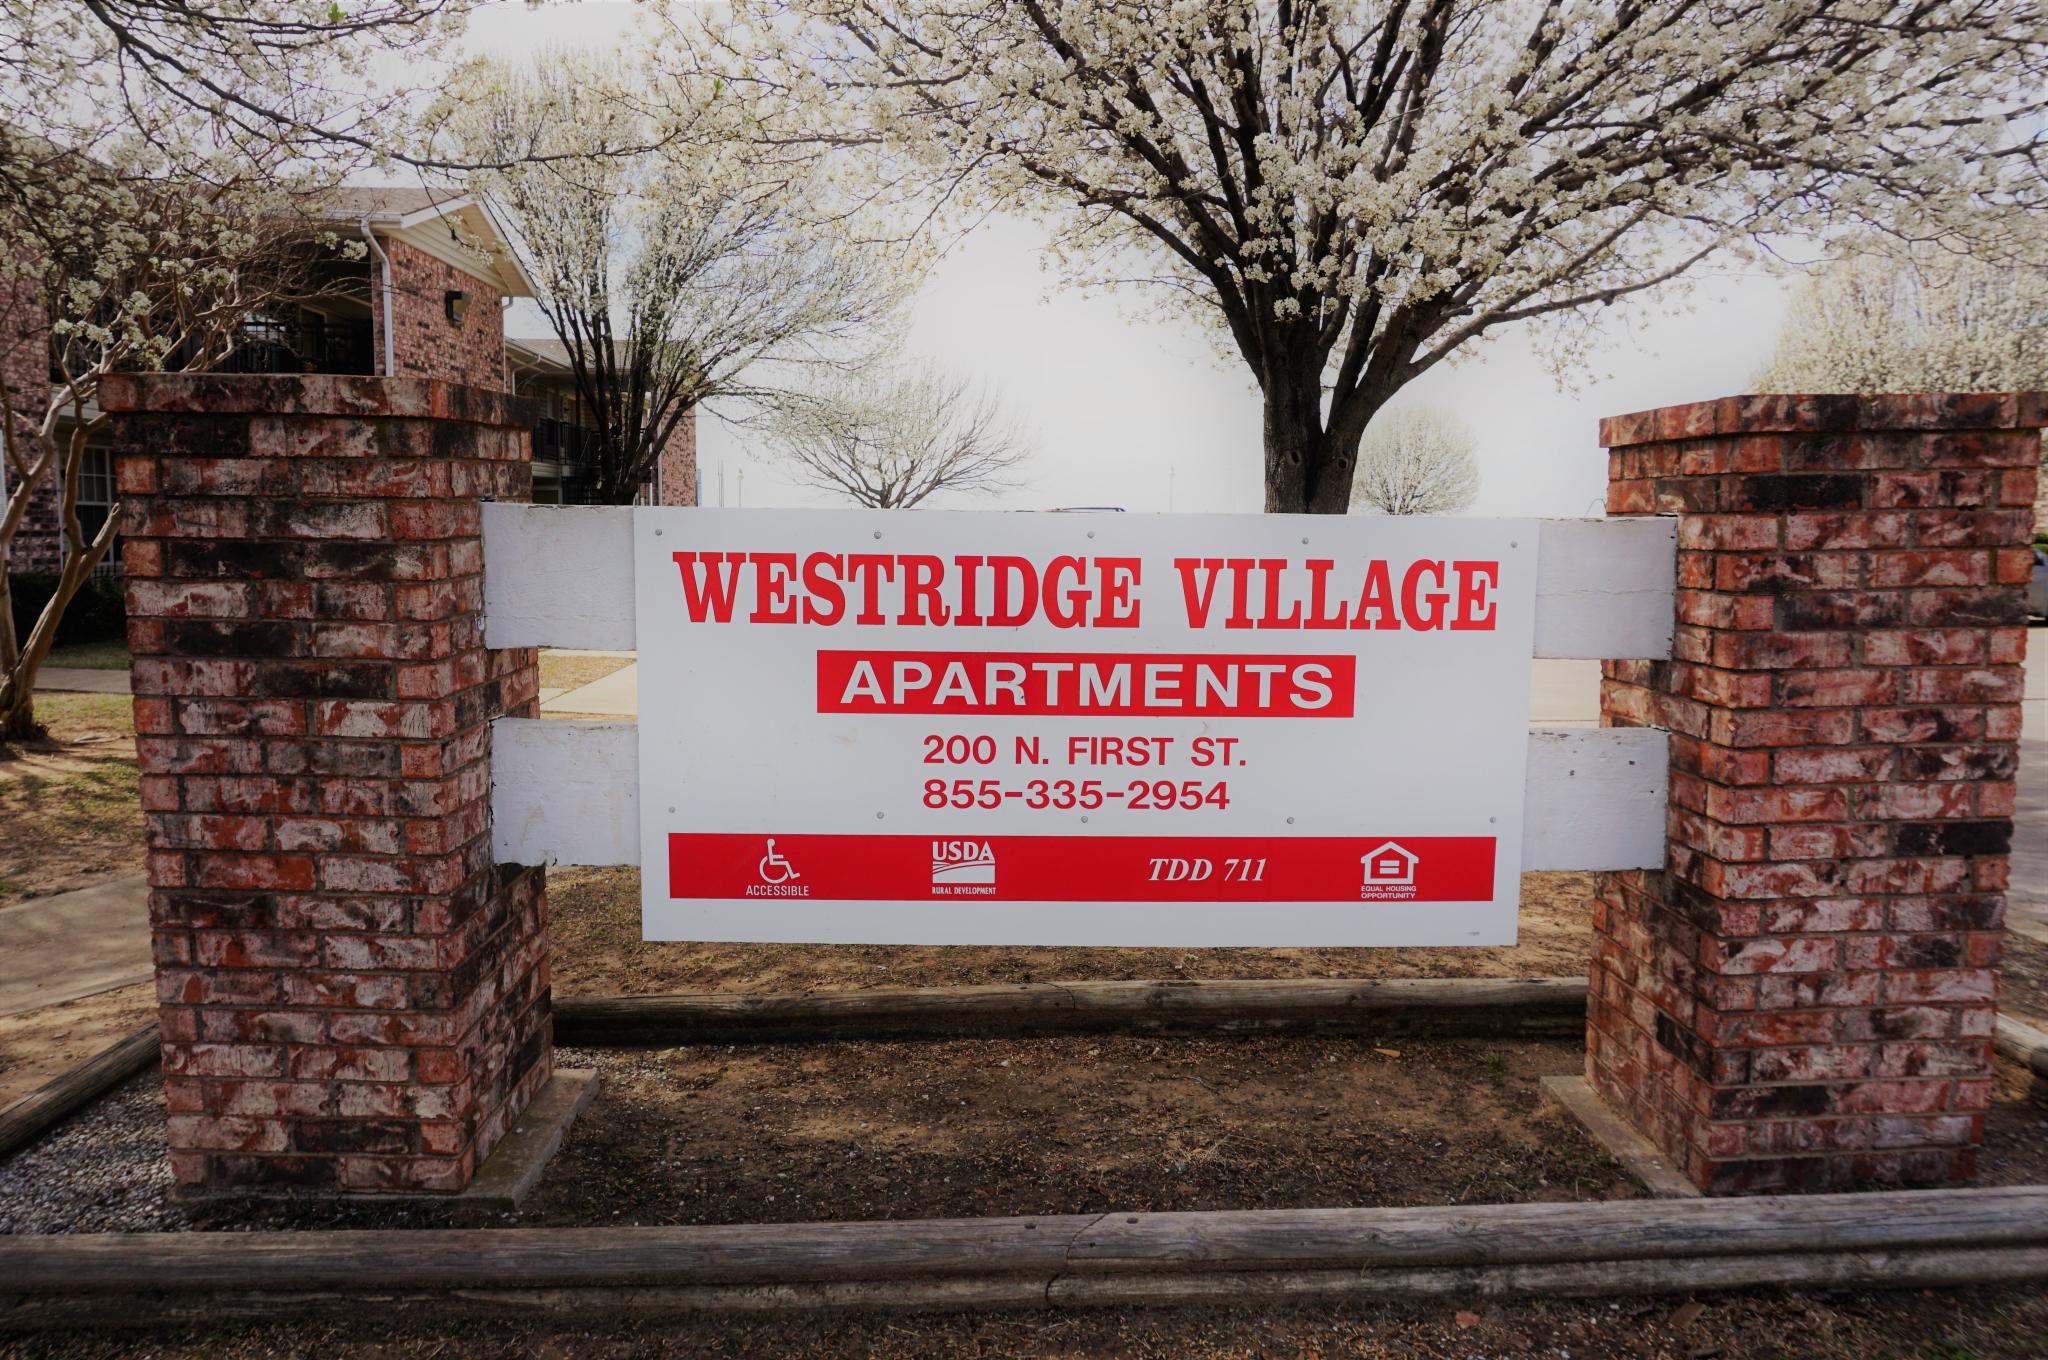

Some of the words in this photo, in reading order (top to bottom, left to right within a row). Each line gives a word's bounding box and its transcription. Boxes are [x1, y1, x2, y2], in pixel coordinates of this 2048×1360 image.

[672, 552, 1141, 628] WESTRIDGE
[1174, 558, 1499, 632] VILLAGE
[840, 661, 1333, 709] APARTMENTS
[923, 735, 997, 765] 200
[1015, 735, 1050, 766] N.
[1067, 736, 1175, 767] FIRST
[1190, 737, 1247, 767] ST.
[922, 779, 1231, 810] 855-335-2954
[931, 841, 996, 861] USDA
[1148, 857, 1213, 881] TDD
[1223, 858, 1267, 881] 711
[746, 883, 809, 897] ACCESSIBLE
[931, 886, 952, 895] RURAL
[953, 886, 996, 895] DEVELOPMENT
